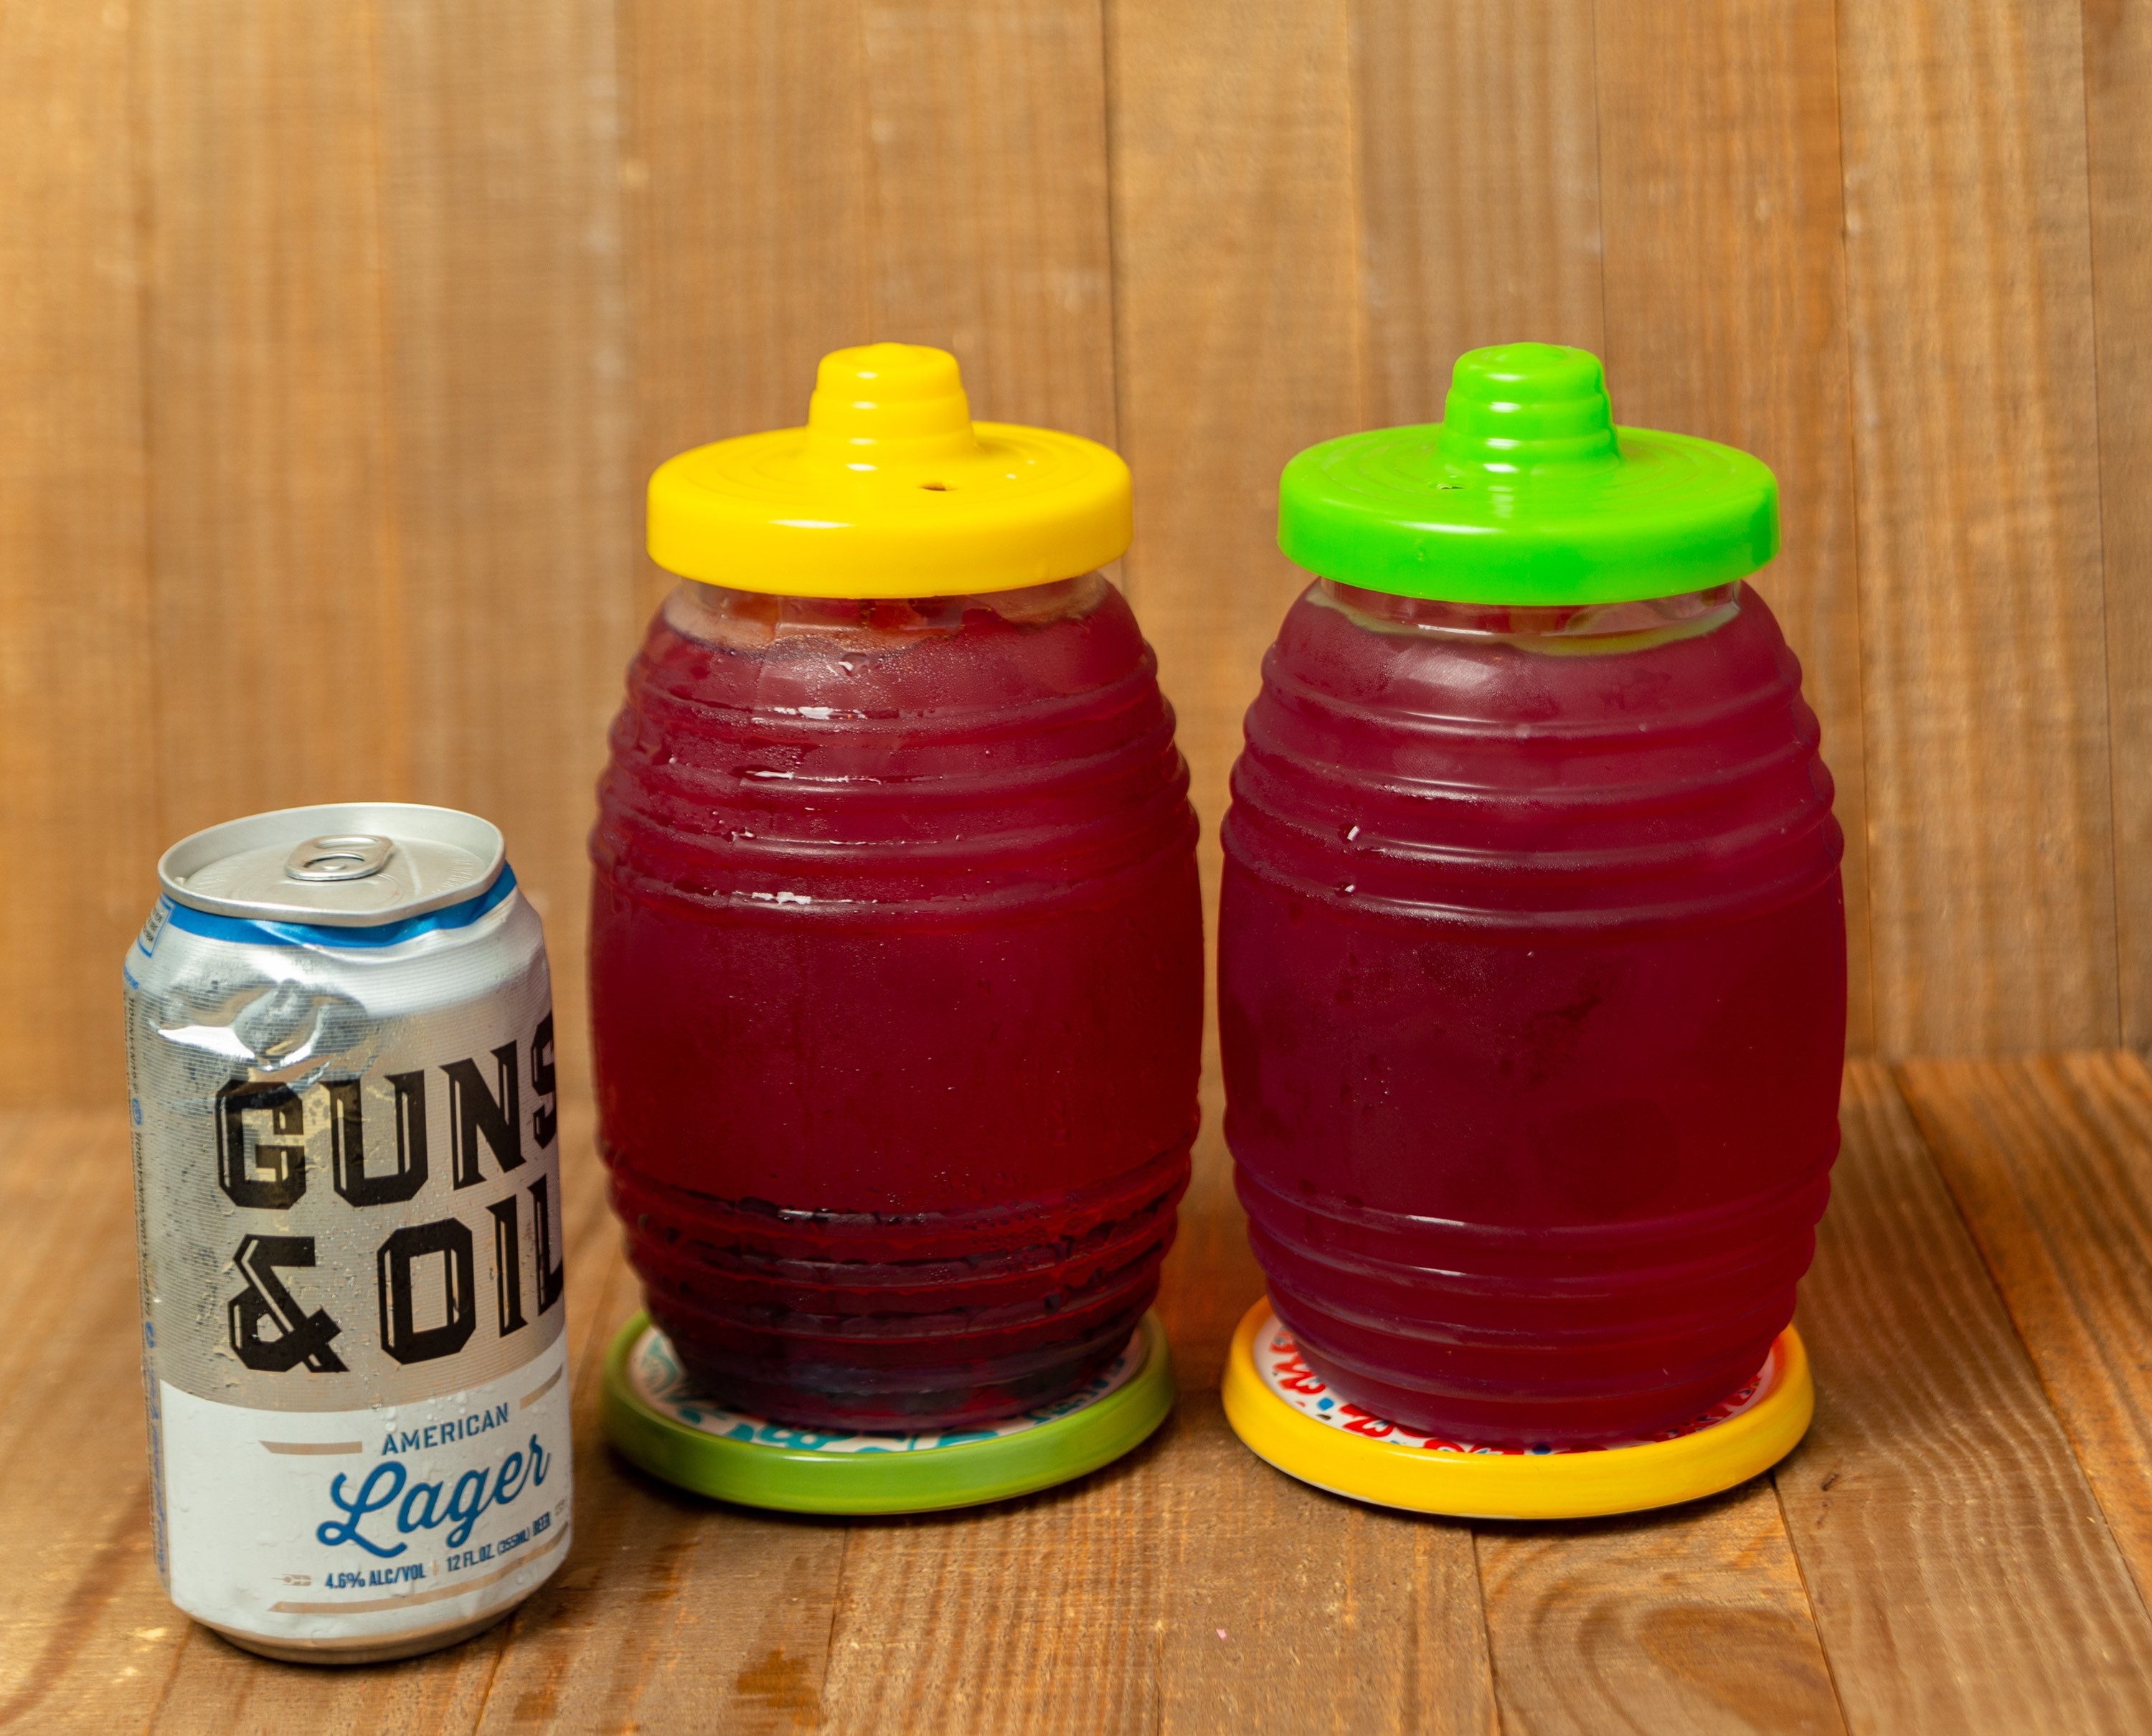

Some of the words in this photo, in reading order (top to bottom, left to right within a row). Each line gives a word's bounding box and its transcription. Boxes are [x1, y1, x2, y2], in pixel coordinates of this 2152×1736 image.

[216, 1009, 557, 1210] GUNS
[227, 1234, 350, 1373] &
[377, 1174, 564, 1366] OIL
[382, 1402, 509, 1456] AMERICAN
[316, 1434, 551, 1558] Lager
[326, 1571, 366, 1589] 4.6%
[369, 1563, 426, 1586] ALC/VOL
[446, 1555, 461, 1572] 12
[532, 1511, 551, 1537] BEER
